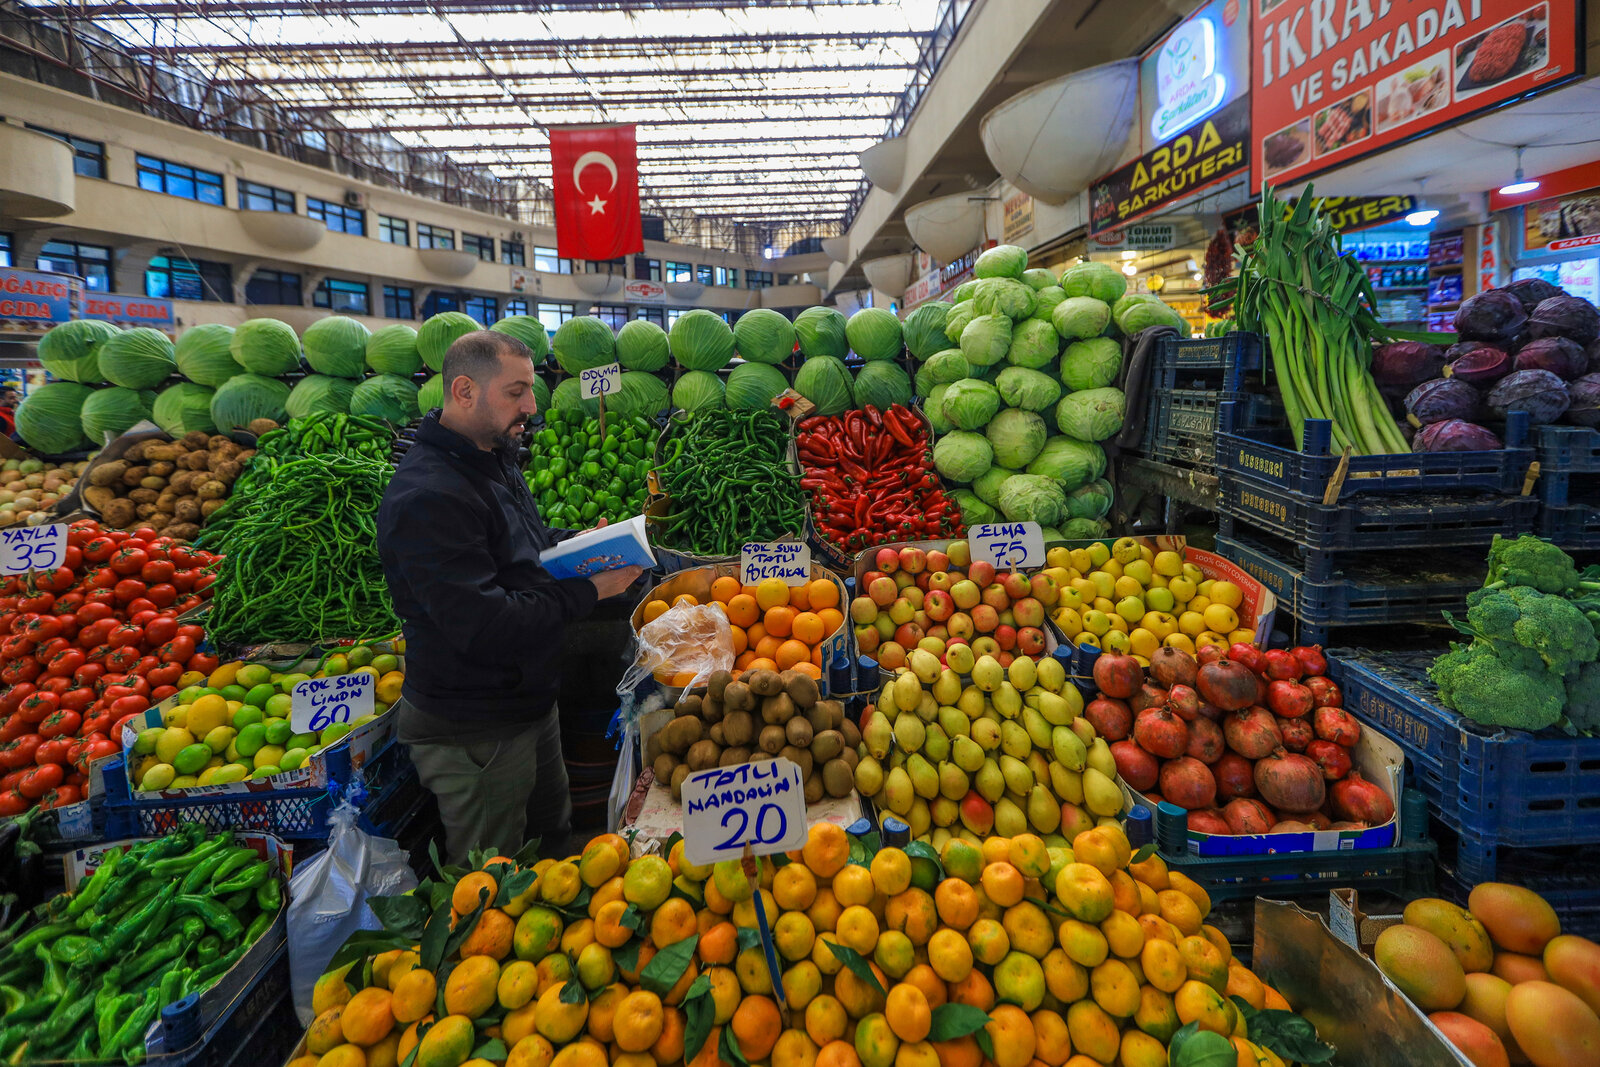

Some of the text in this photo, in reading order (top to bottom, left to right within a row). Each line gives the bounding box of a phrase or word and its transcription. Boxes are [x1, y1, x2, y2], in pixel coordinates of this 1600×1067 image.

[1262, 0, 1393, 88] İKRA
[1290, 69, 1324, 112] VE
[1130, 120, 1222, 192] ARDA
[1118, 142, 1243, 219] ŞARKÜTERİ
[0, 275, 67, 301] ĞAZİÇİ
[0, 300, 52, 318] GIDA
[126, 303, 169, 319] GIDA
[582, 365, 618, 380] DOLMA
[591, 378, 610, 395] 60
[2, 525, 58, 544] YAYLA
[976, 523, 1027, 539] ELMA
[6, 542, 56, 570] 35
[751, 553, 795, 563] TATLI
[774, 543, 802, 553] SULU
[989, 541, 1028, 567] 75
[1195, 554, 1214, 564] 100%
[1215, 560, 1231, 572] GREY
[1231, 568, 1258, 593] COVERAGE
[336, 674, 370, 689] SULU
[311, 688, 362, 706] LİMON
[309, 703, 350, 732] 60
[692, 762, 778, 789] TATLI
[713, 803, 787, 850] 20
